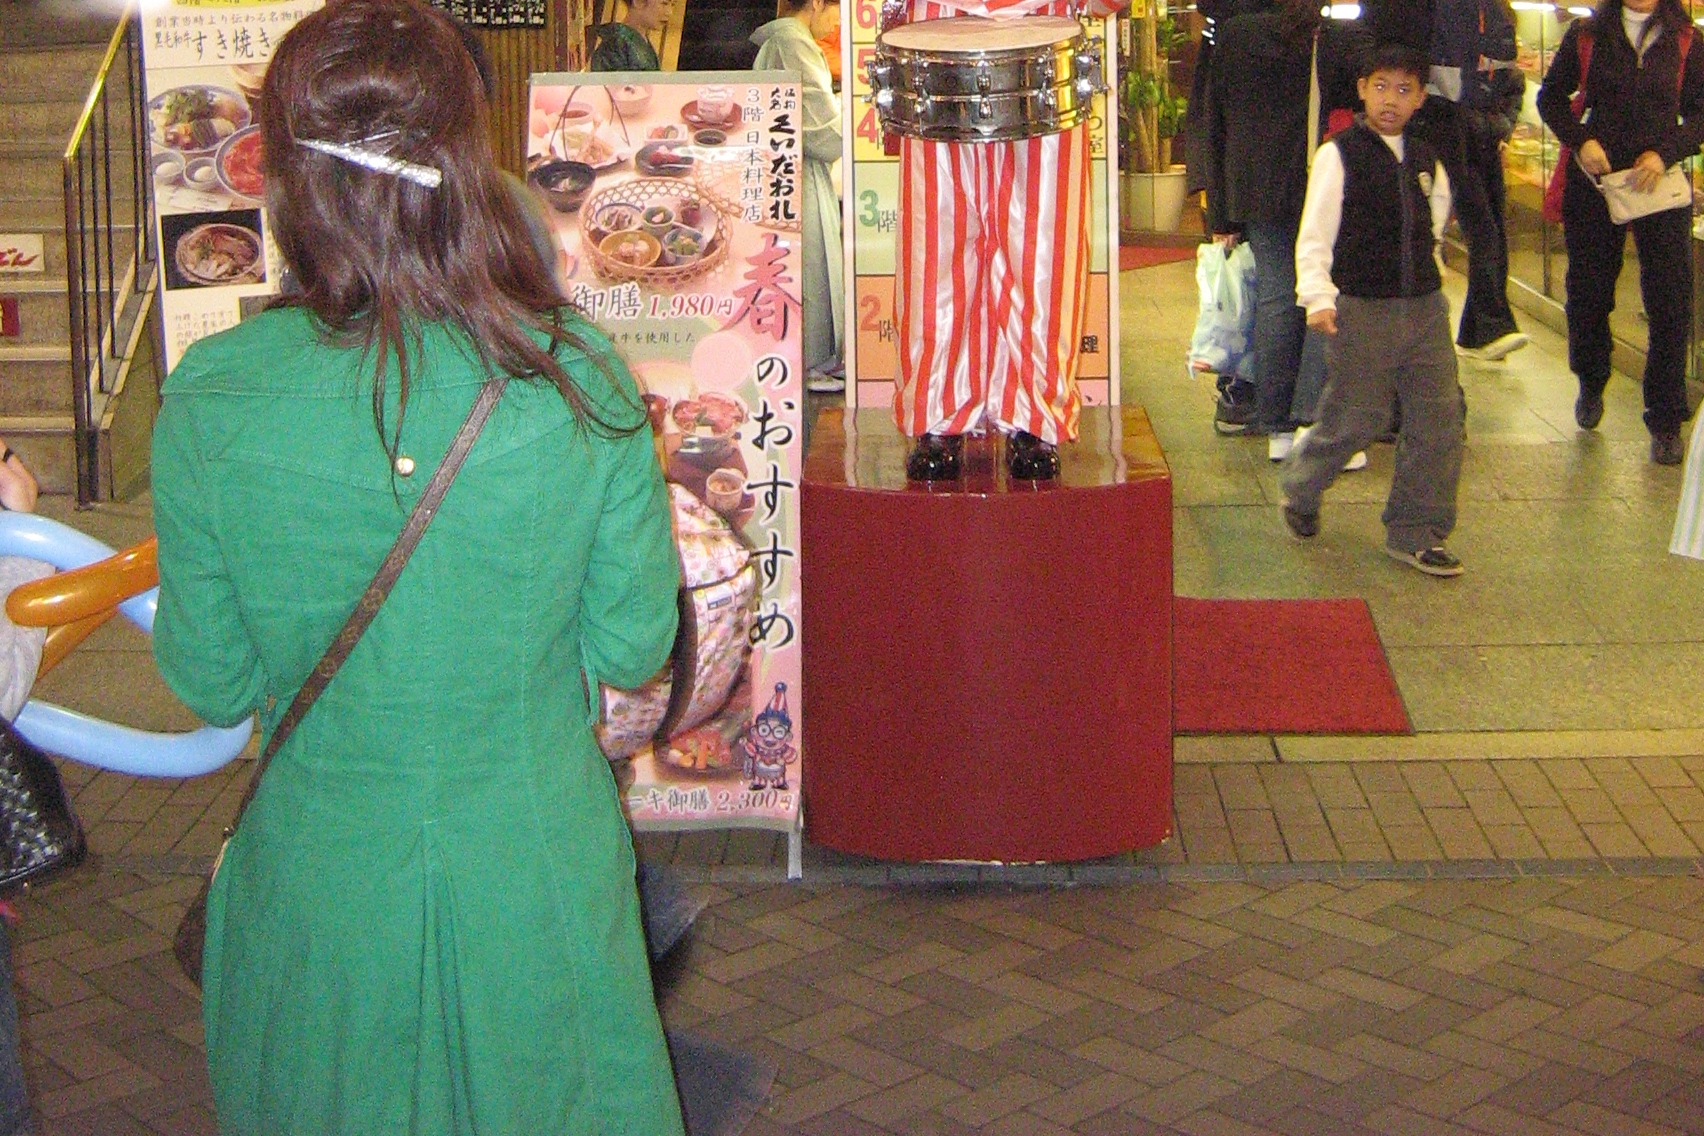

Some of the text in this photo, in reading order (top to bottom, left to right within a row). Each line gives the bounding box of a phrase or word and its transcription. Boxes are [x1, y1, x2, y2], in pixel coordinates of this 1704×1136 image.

[742, 89, 764, 222] 3階 日本料理店
